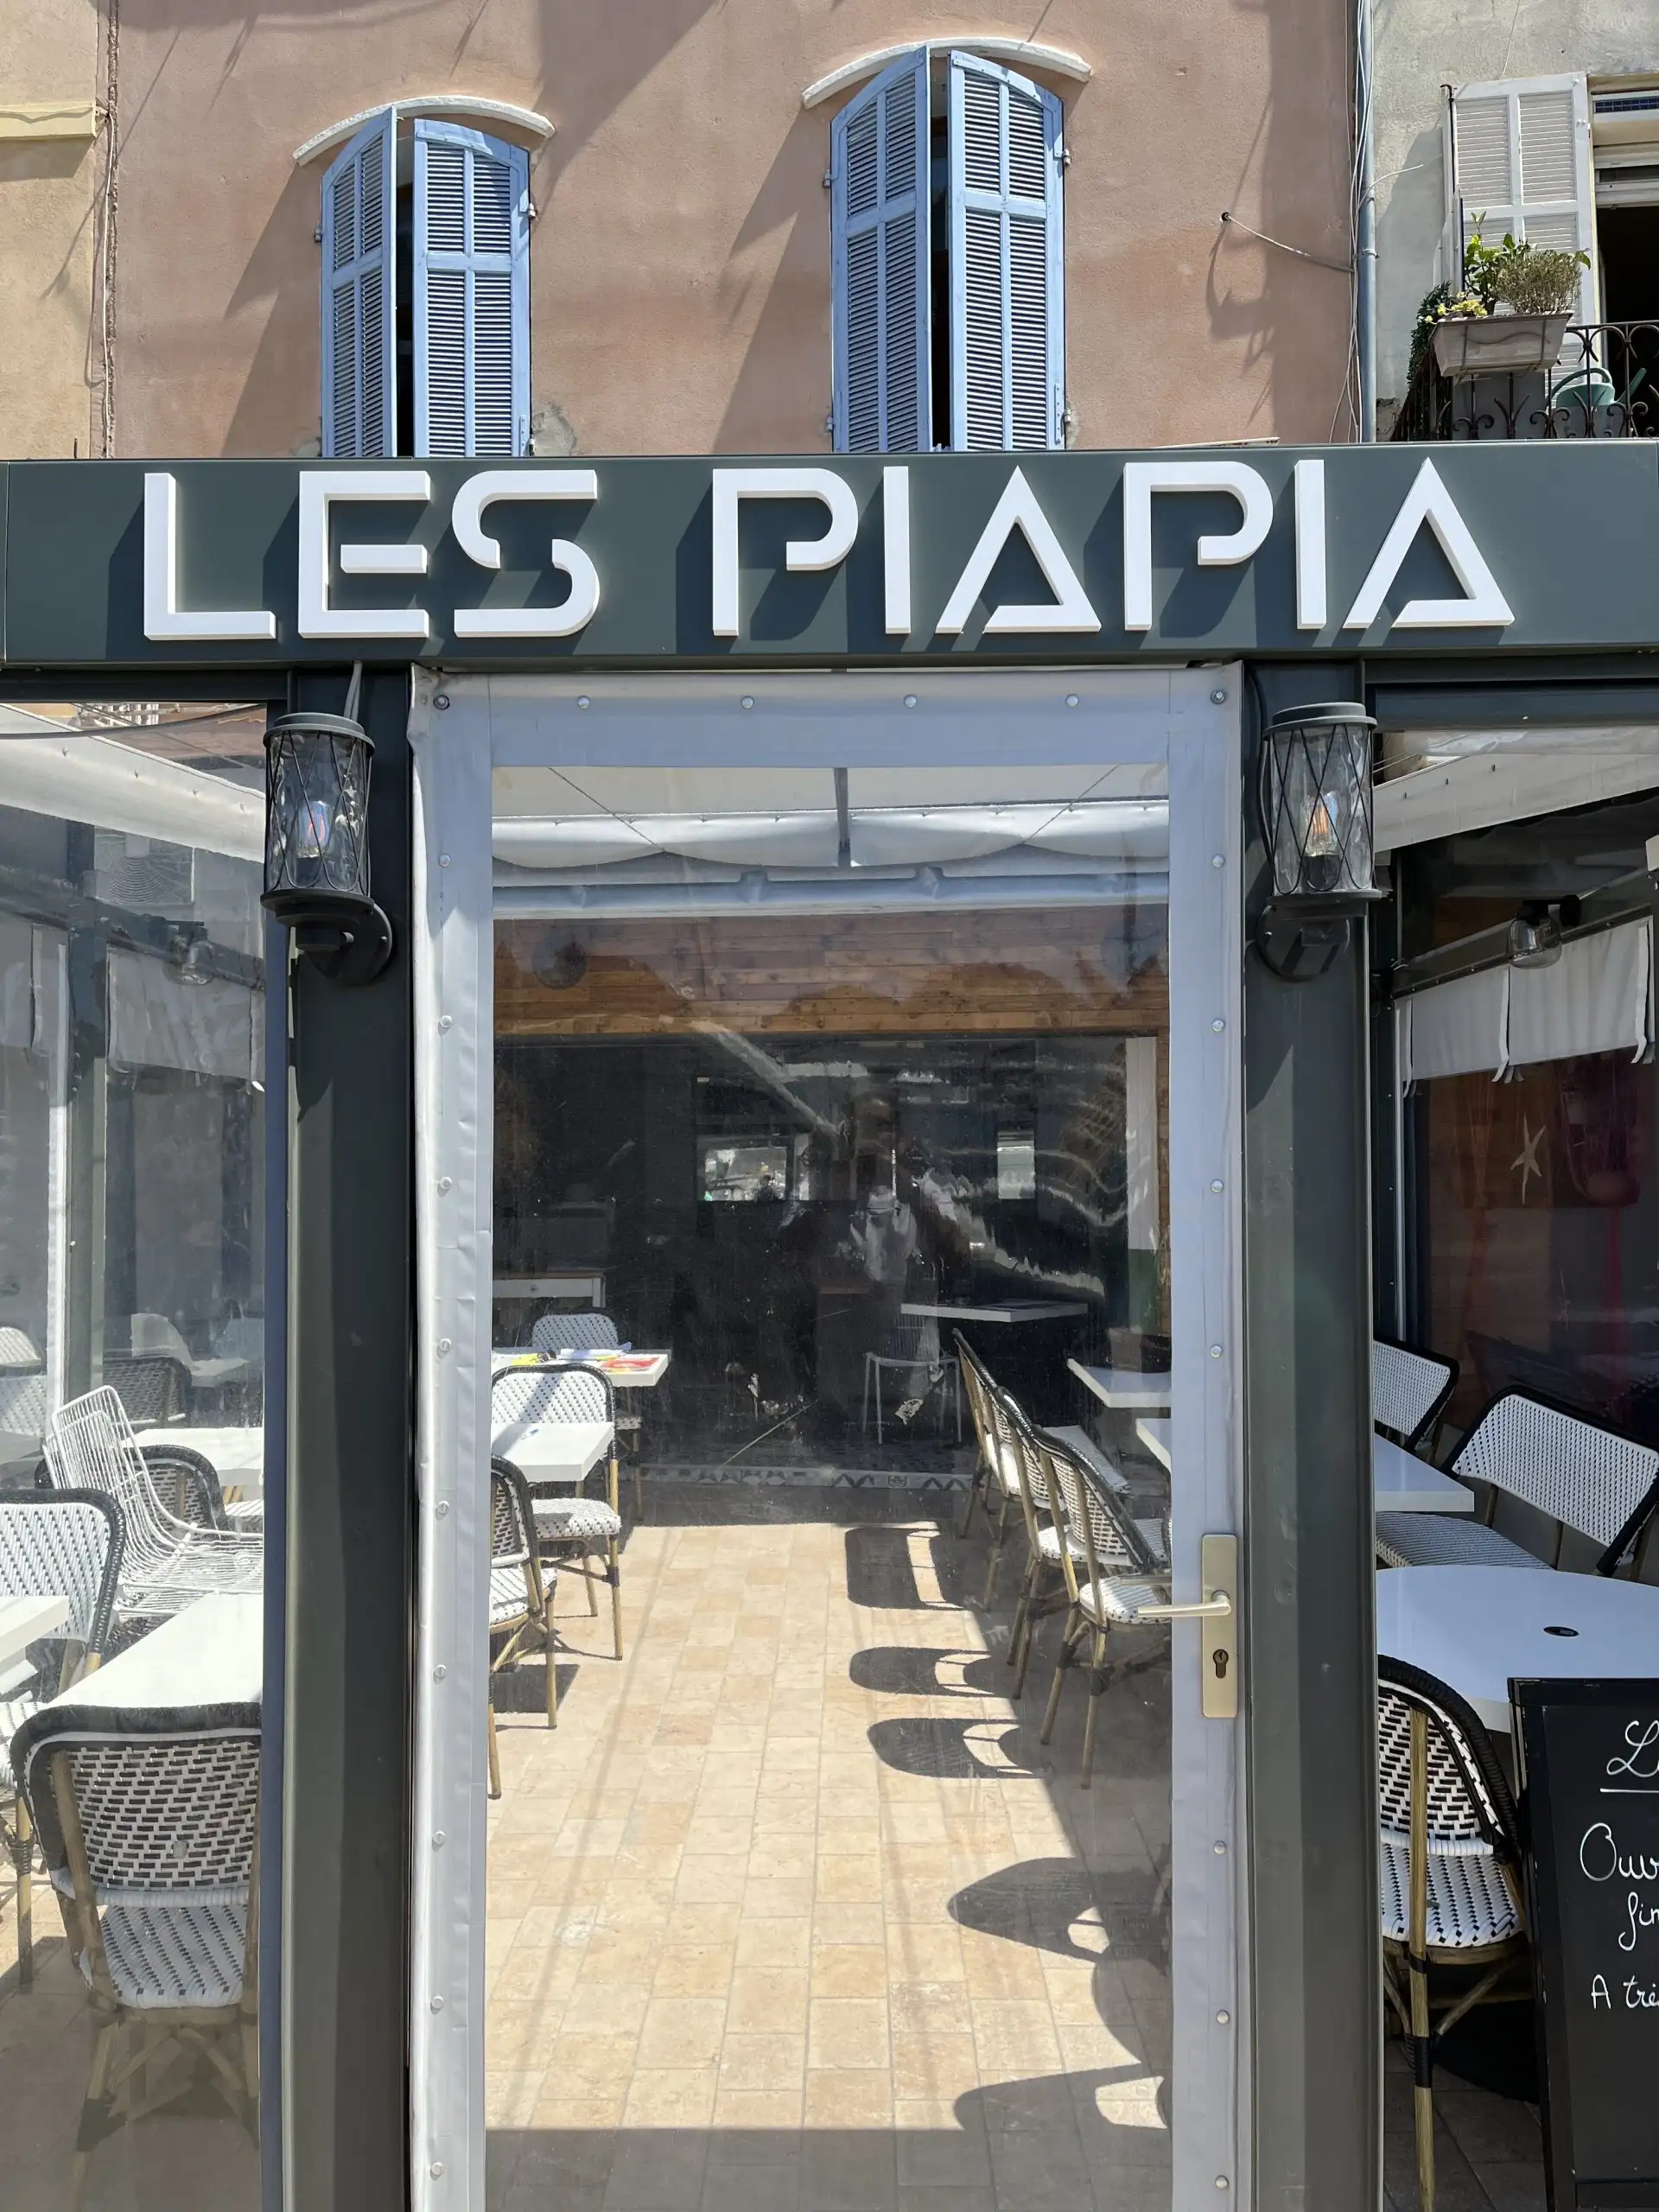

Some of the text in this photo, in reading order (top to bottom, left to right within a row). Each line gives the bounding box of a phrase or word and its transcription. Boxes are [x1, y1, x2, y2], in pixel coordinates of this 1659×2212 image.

[143, 456, 1516, 641] LES PIAPIA
[1606, 1719, 1659, 1777] L
[1591, 1974, 1611, 2010] A
